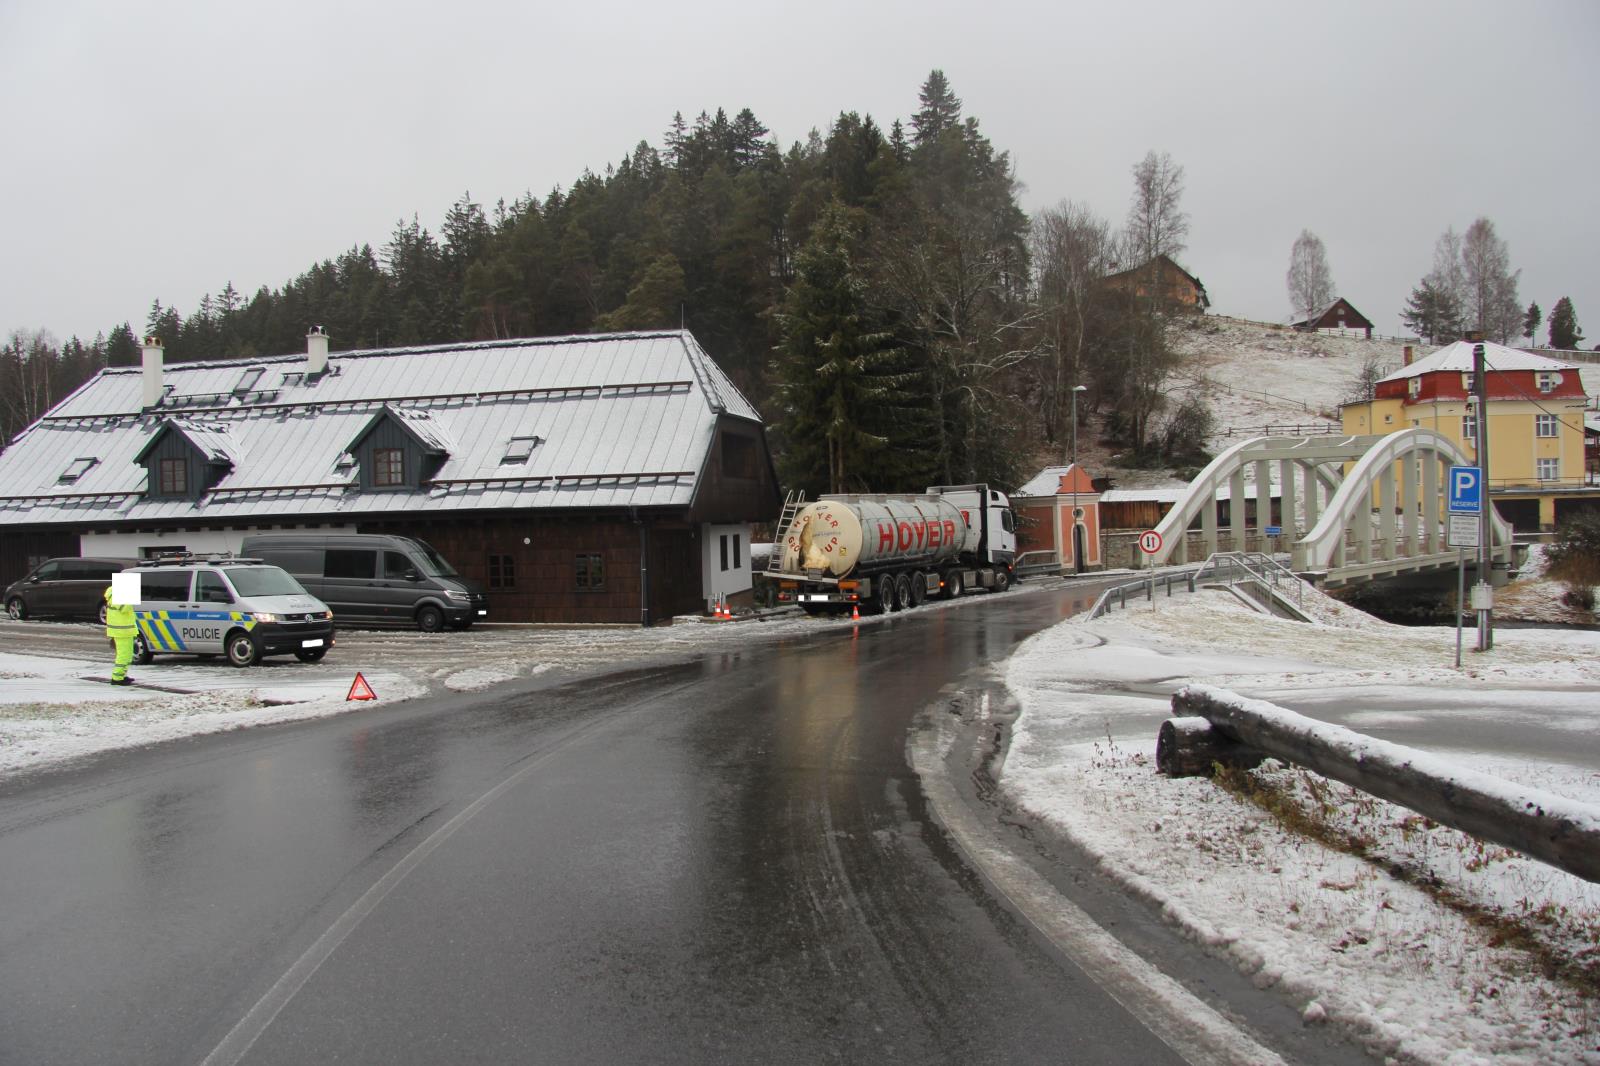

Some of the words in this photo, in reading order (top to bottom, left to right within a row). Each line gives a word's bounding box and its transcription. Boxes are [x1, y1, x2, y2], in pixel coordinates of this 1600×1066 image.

[1456, 472, 1475, 499] P
[794, 513, 838, 528] HOYER
[878, 520, 954, 553] HOYER
[182, 627, 220, 640] POLICIE
